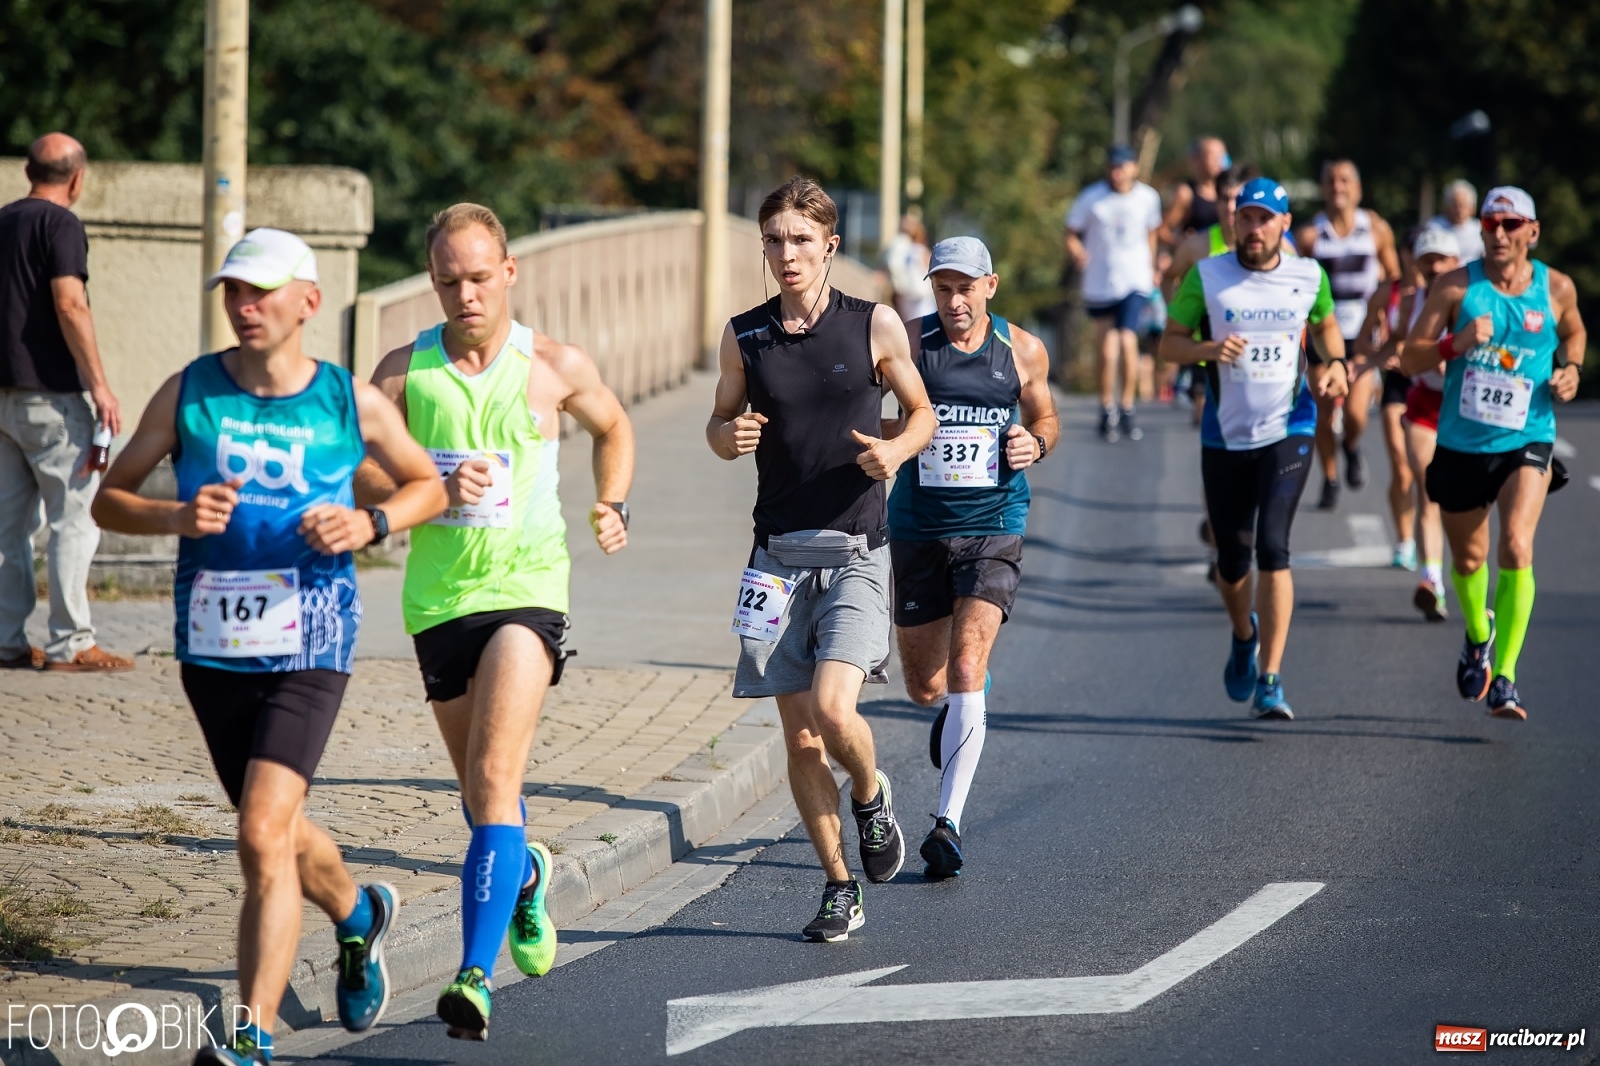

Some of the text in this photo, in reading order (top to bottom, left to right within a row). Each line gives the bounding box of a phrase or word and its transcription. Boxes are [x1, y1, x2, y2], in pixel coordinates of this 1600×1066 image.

[1251, 346, 1281, 362] 235
[1481, 387, 1513, 407] 282
[943, 443, 980, 463] 337
[238, 493, 290, 510] ACIBORZ
[737, 585, 768, 612] 122
[218, 596, 268, 622] 167
